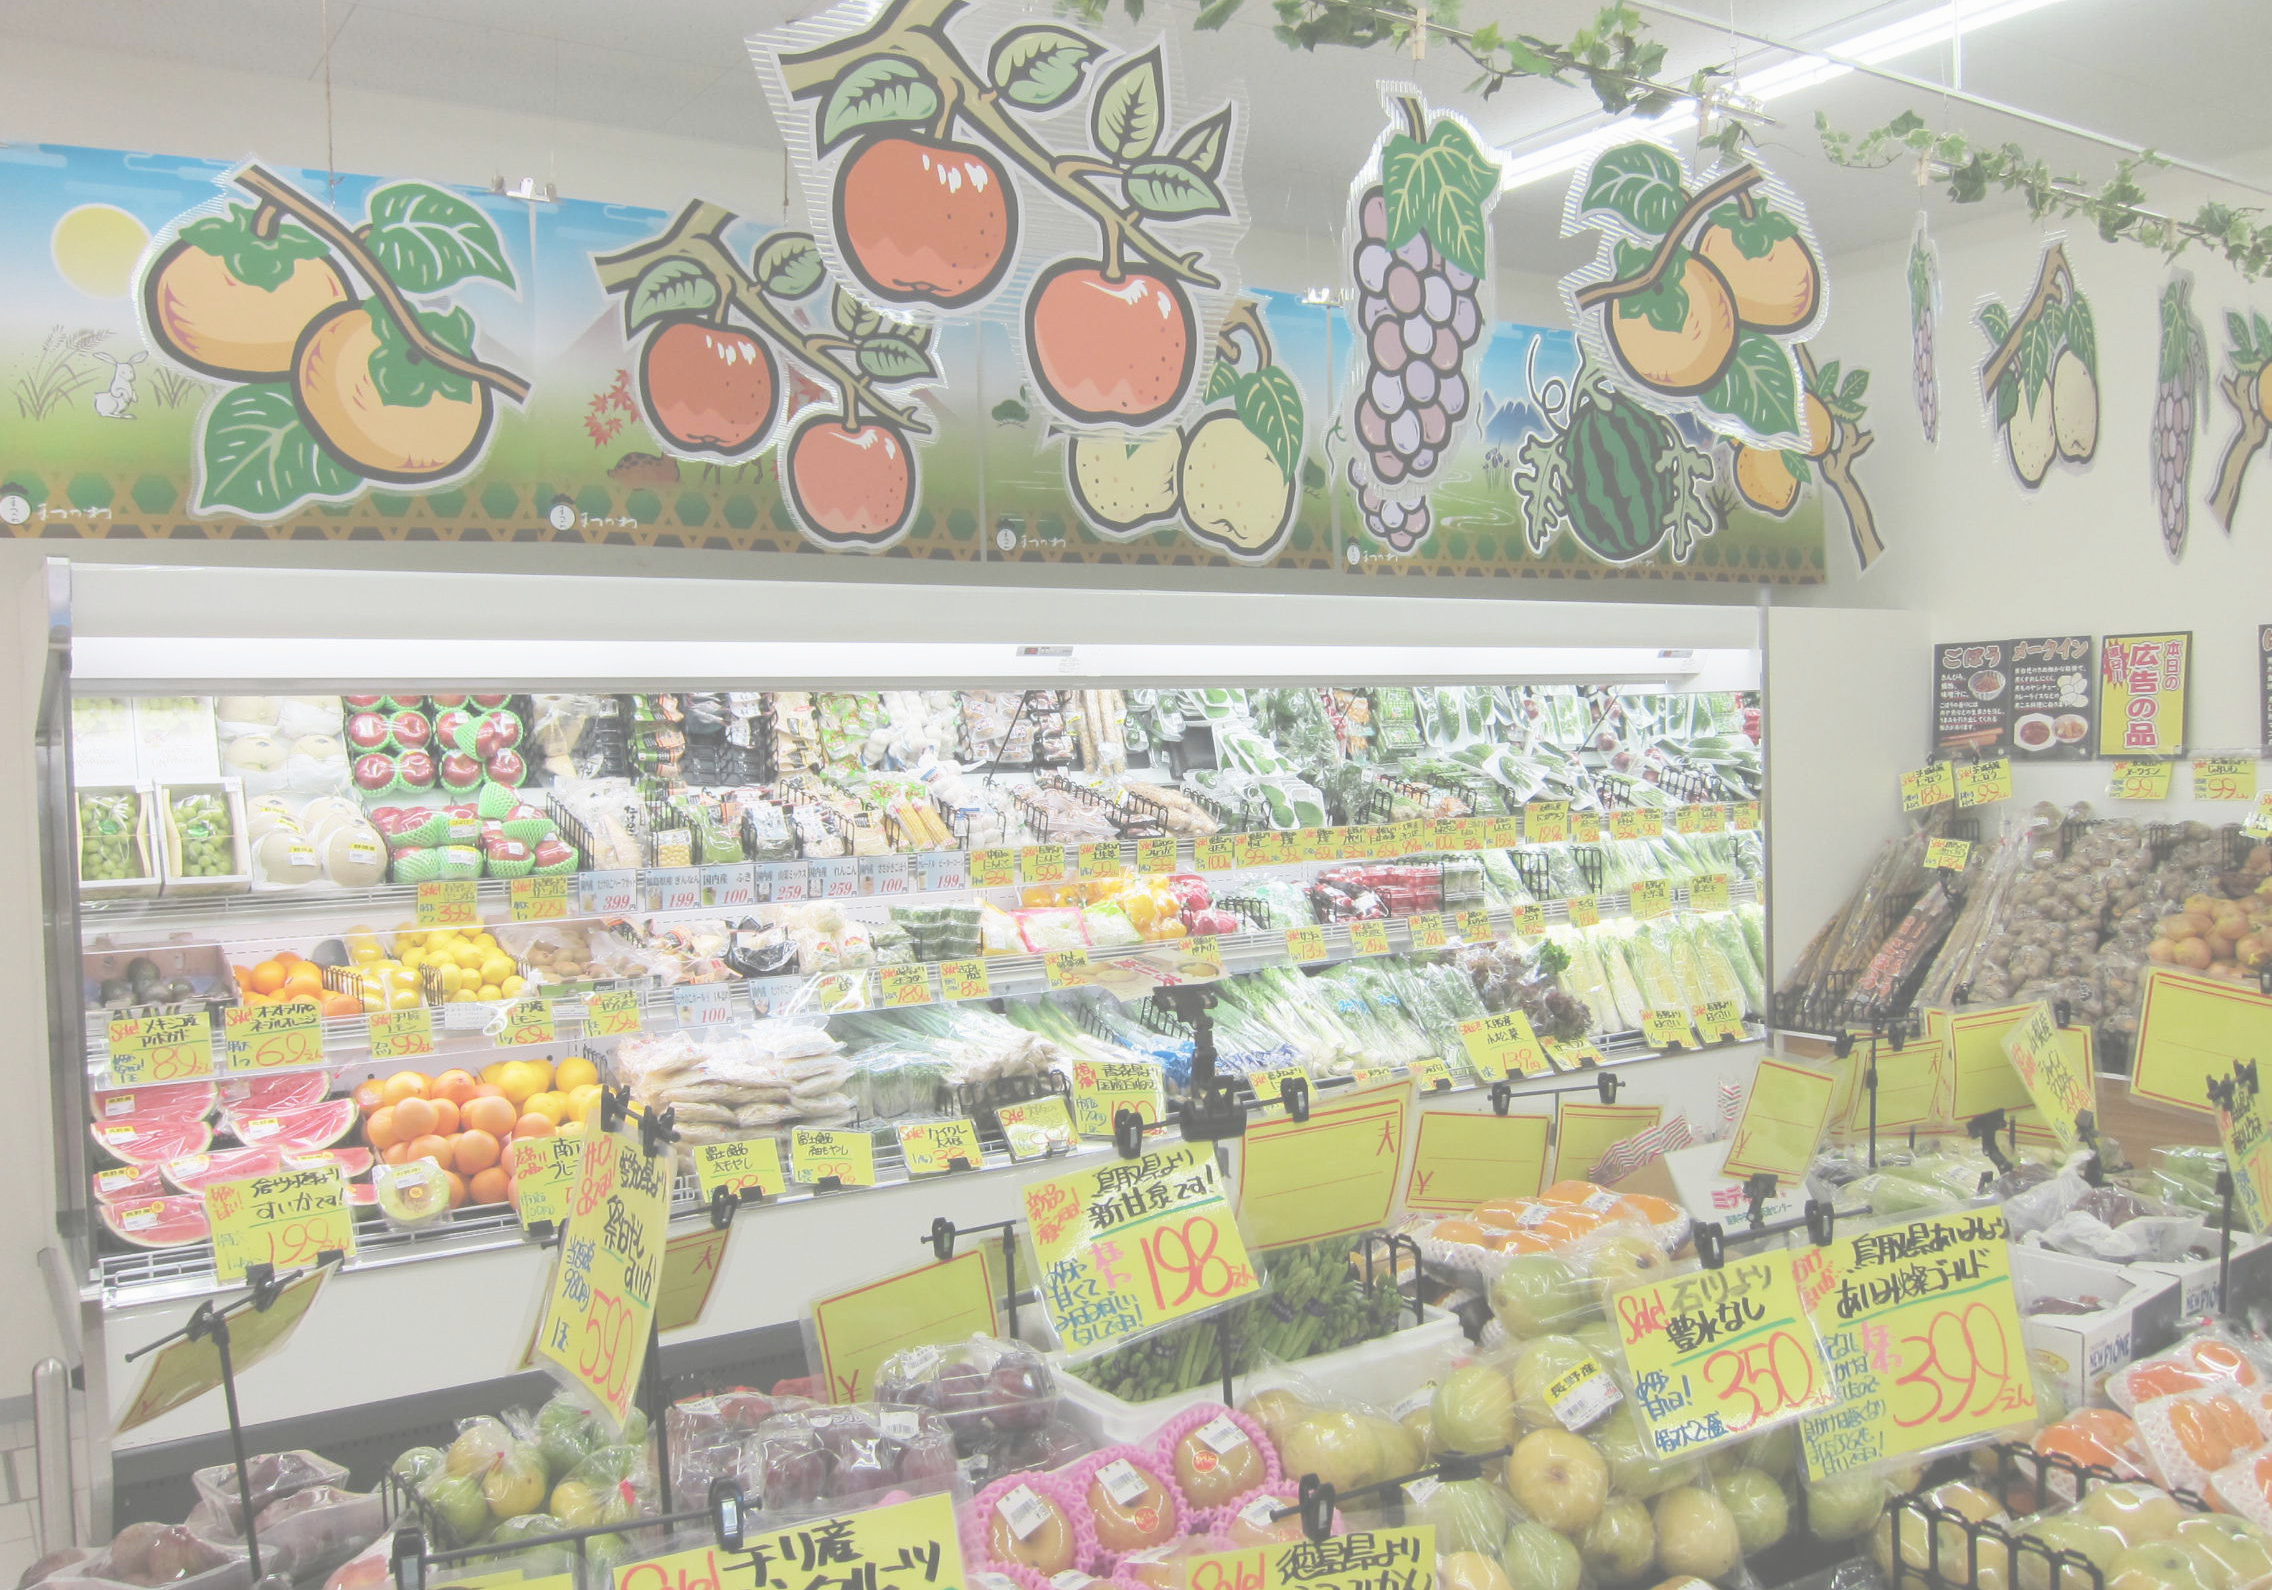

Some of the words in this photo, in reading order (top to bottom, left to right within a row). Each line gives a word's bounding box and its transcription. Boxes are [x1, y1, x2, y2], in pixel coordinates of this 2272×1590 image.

[2162, 640, 2184, 692] 本日の
[2123, 641, 2163, 749] 広告の品
[703, 872, 727, 885] 国内産
[1091, 1149, 1195, 1197] 鳥取県より
[1666, 1296, 1766, 1355] 豊水なし
[722, 1518, 863, 1588] チリ産
[1275, 1532, 1420, 1587] 徳島県より
